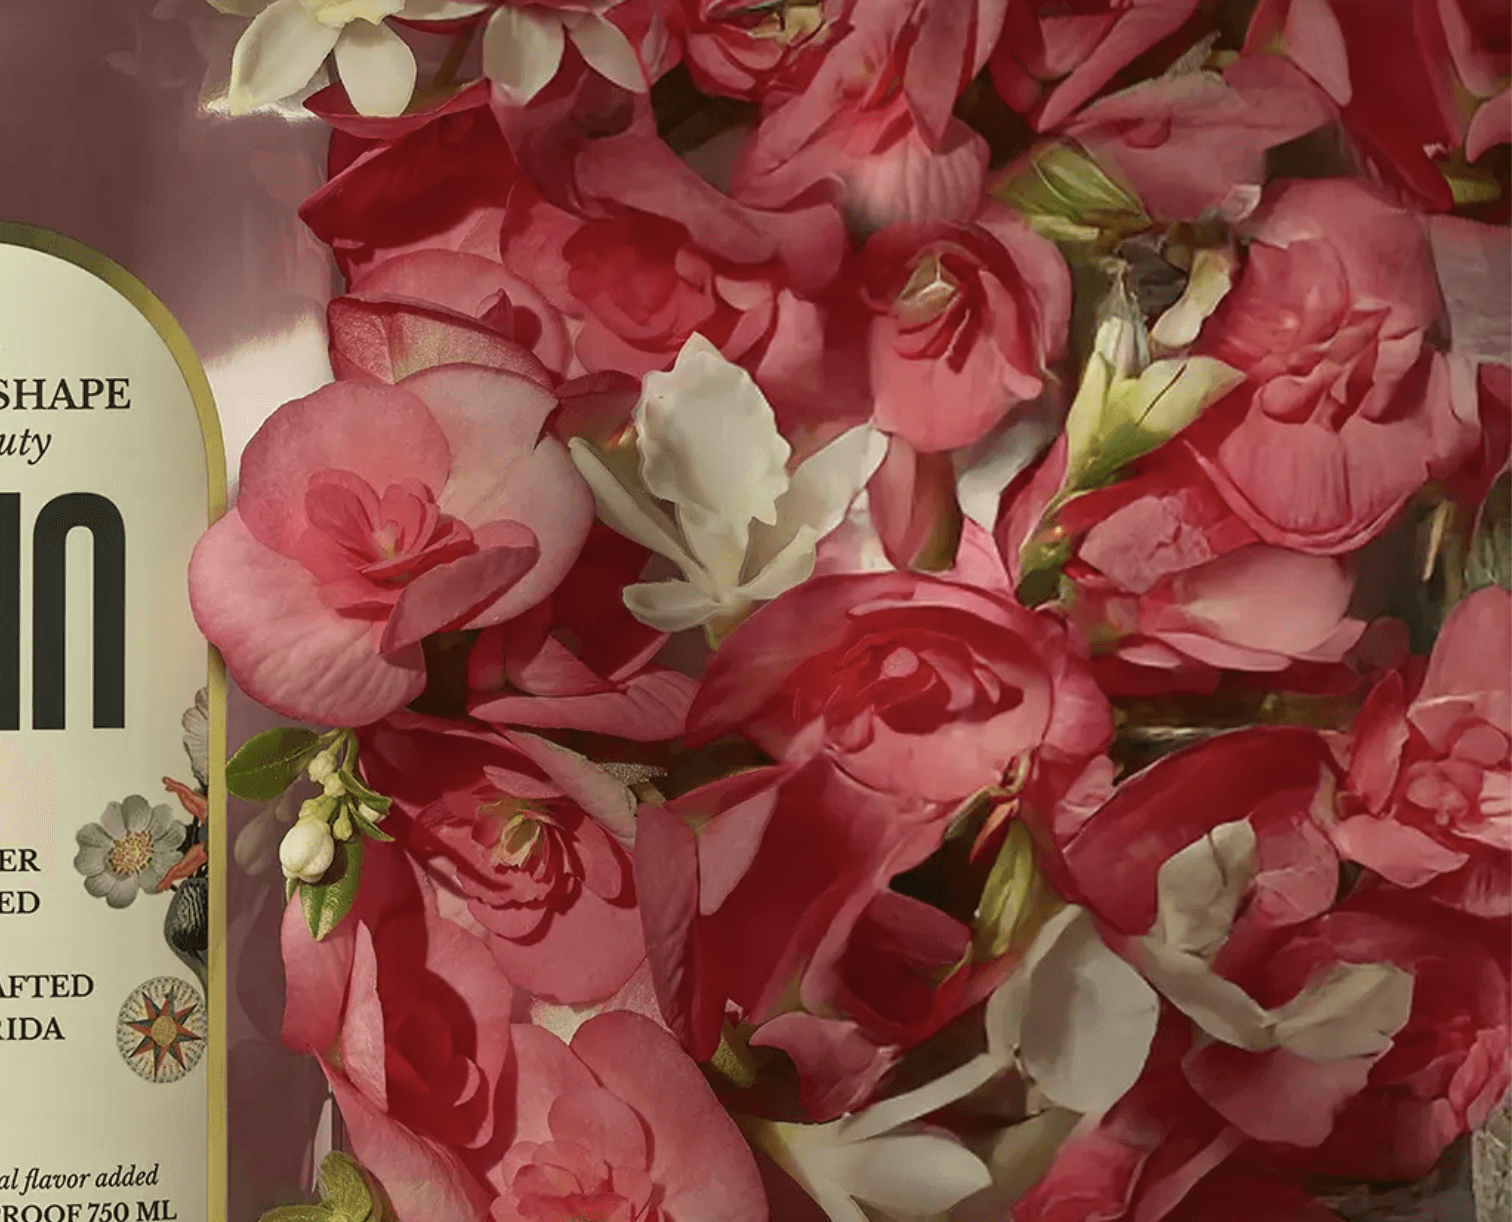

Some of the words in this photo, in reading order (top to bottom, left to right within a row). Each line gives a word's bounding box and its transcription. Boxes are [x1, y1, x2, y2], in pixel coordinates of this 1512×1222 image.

[19, 1167, 92, 1196] flavor
[94, 1162, 160, 1188] added
[88, 1201, 130, 1222] 750
[136, 1199, 178, 1222] ML
